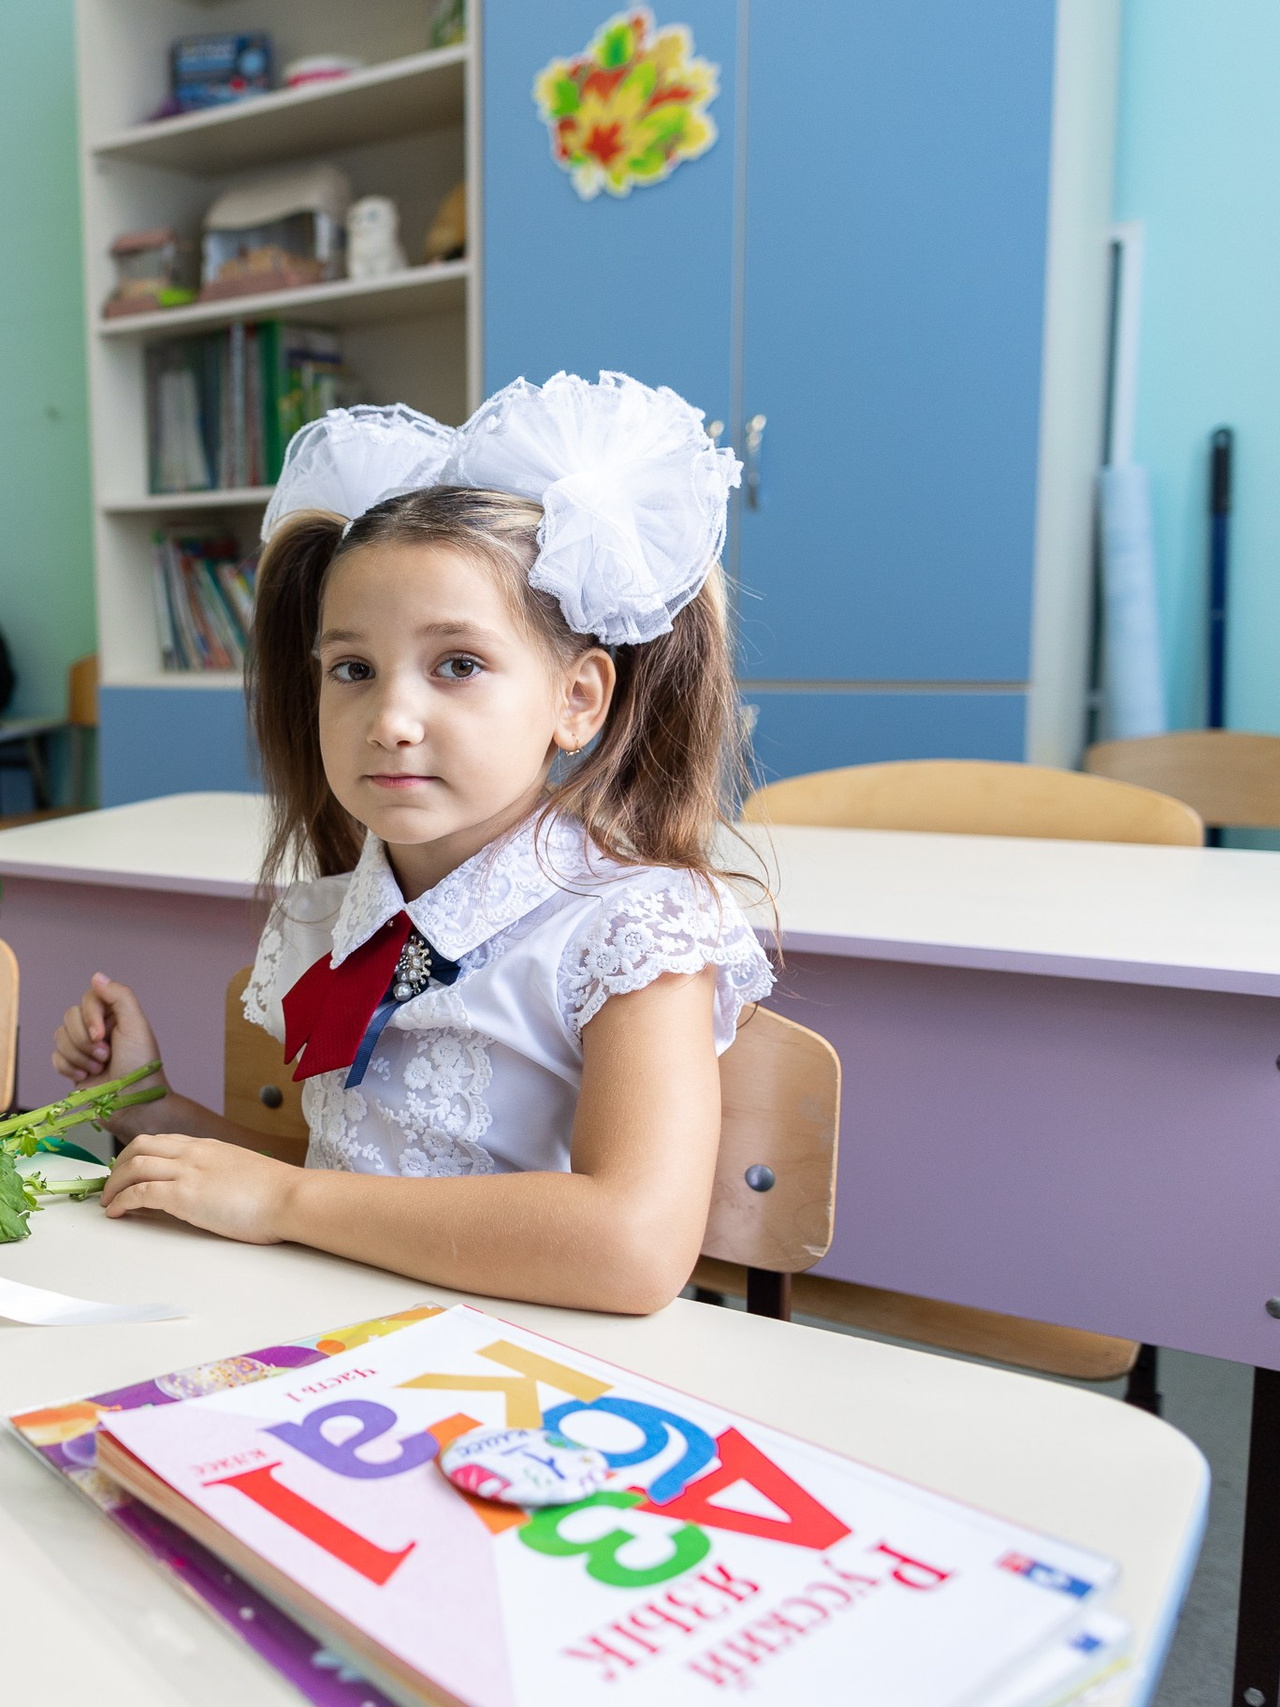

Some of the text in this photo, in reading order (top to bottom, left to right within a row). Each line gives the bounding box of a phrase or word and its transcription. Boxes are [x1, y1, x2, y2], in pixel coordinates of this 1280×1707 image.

[193, 1449, 268, 1476] класс
[202, 1462, 417, 1586] 1
[687, 1540, 954, 1690] Русский
